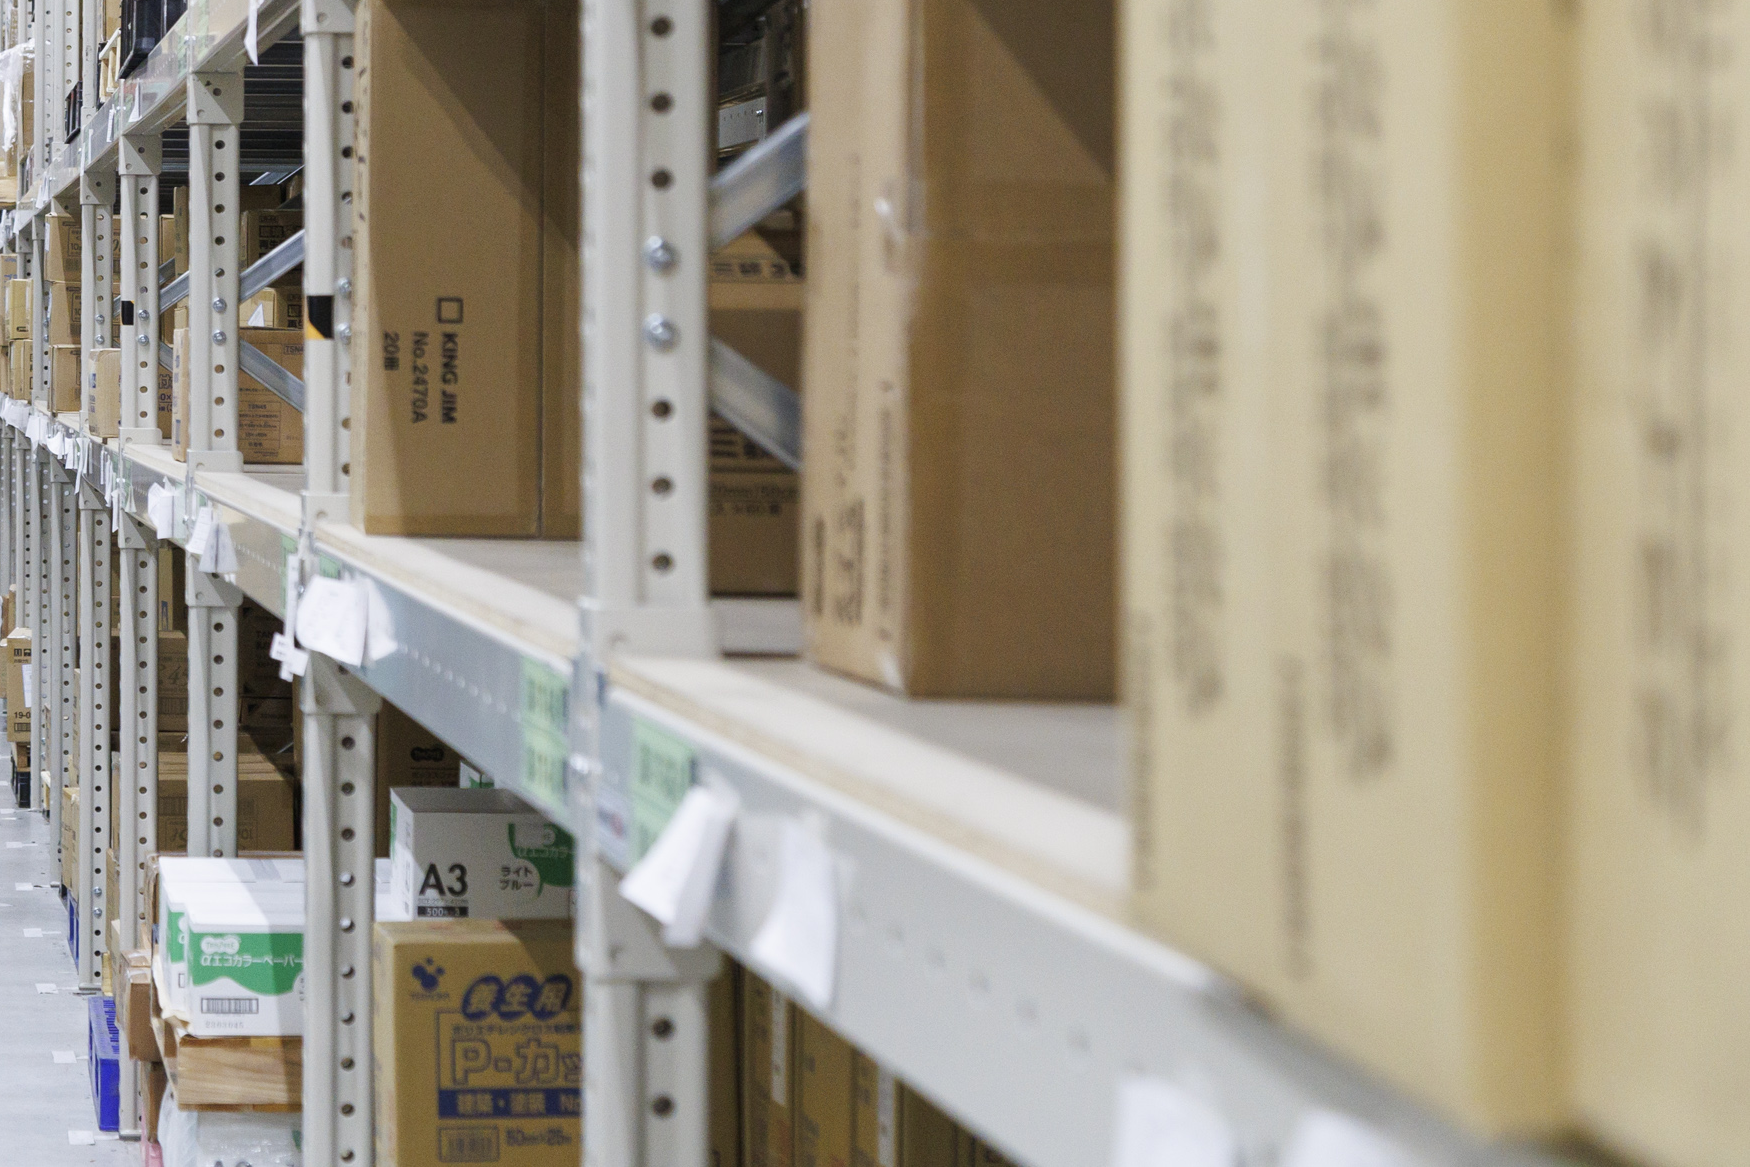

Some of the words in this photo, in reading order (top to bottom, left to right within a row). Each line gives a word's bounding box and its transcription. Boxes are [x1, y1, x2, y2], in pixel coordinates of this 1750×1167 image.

[412, 332, 429, 424] No.2470A
[441, 332, 458, 385] KING
[419, 863, 468, 897] A3
